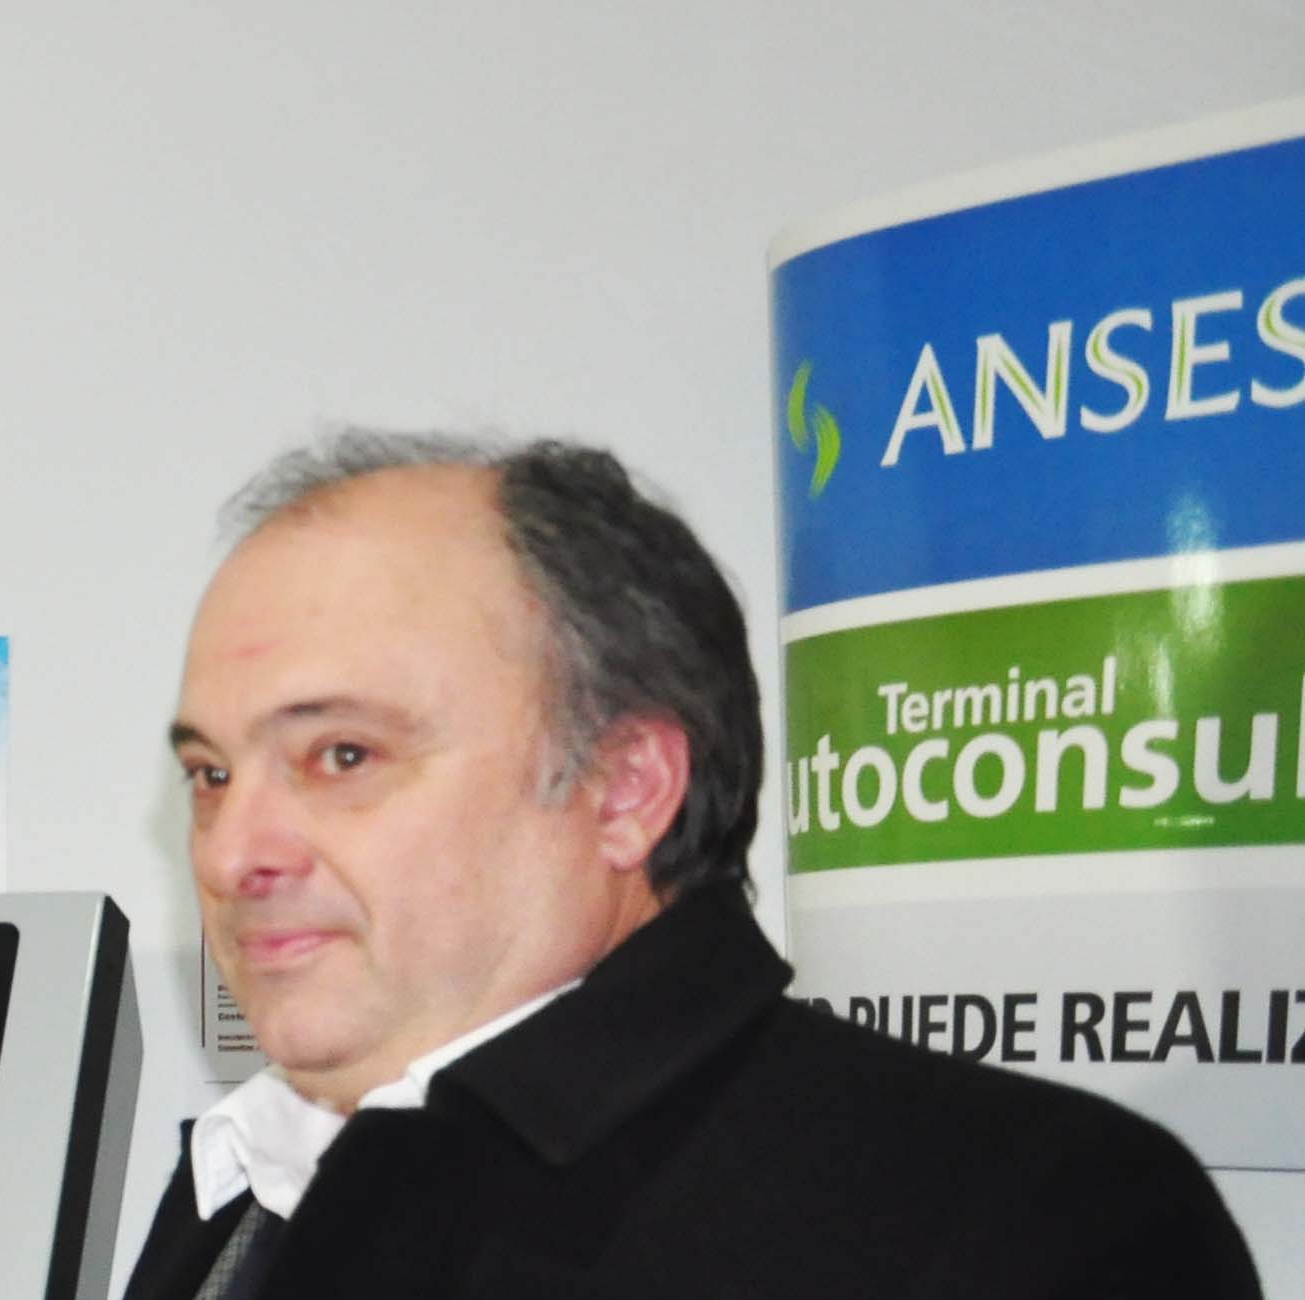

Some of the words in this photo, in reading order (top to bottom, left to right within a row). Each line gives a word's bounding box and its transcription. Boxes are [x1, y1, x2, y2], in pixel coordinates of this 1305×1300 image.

[880, 276, 1305, 468] ANSES
[878, 655, 1117, 735] Terminal
[1059, 990, 1305, 1065] REALI
